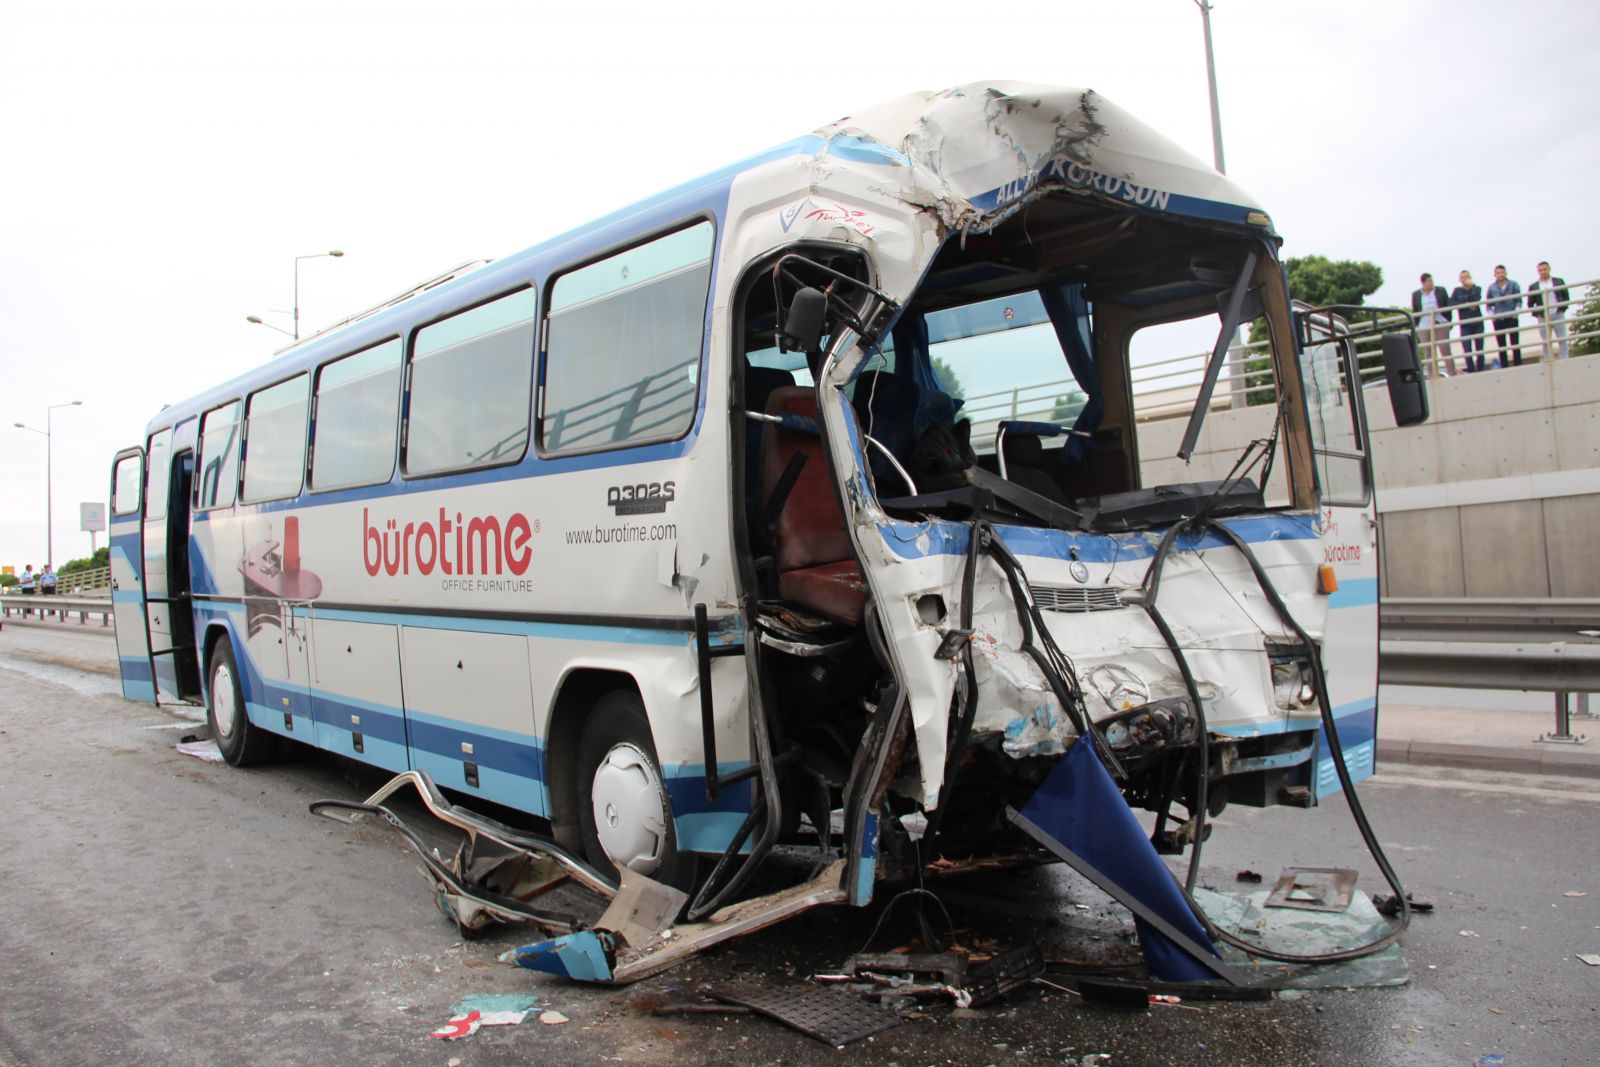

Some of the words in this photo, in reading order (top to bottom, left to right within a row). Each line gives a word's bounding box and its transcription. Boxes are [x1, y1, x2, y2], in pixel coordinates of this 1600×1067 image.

[996, 171, 1040, 205] ALL
[362, 506, 534, 578] bürotime
[565, 523, 678, 545] www.burotime.com
[441, 579, 474, 592] OFFICE
[476, 579, 534, 593] FURNITURE
